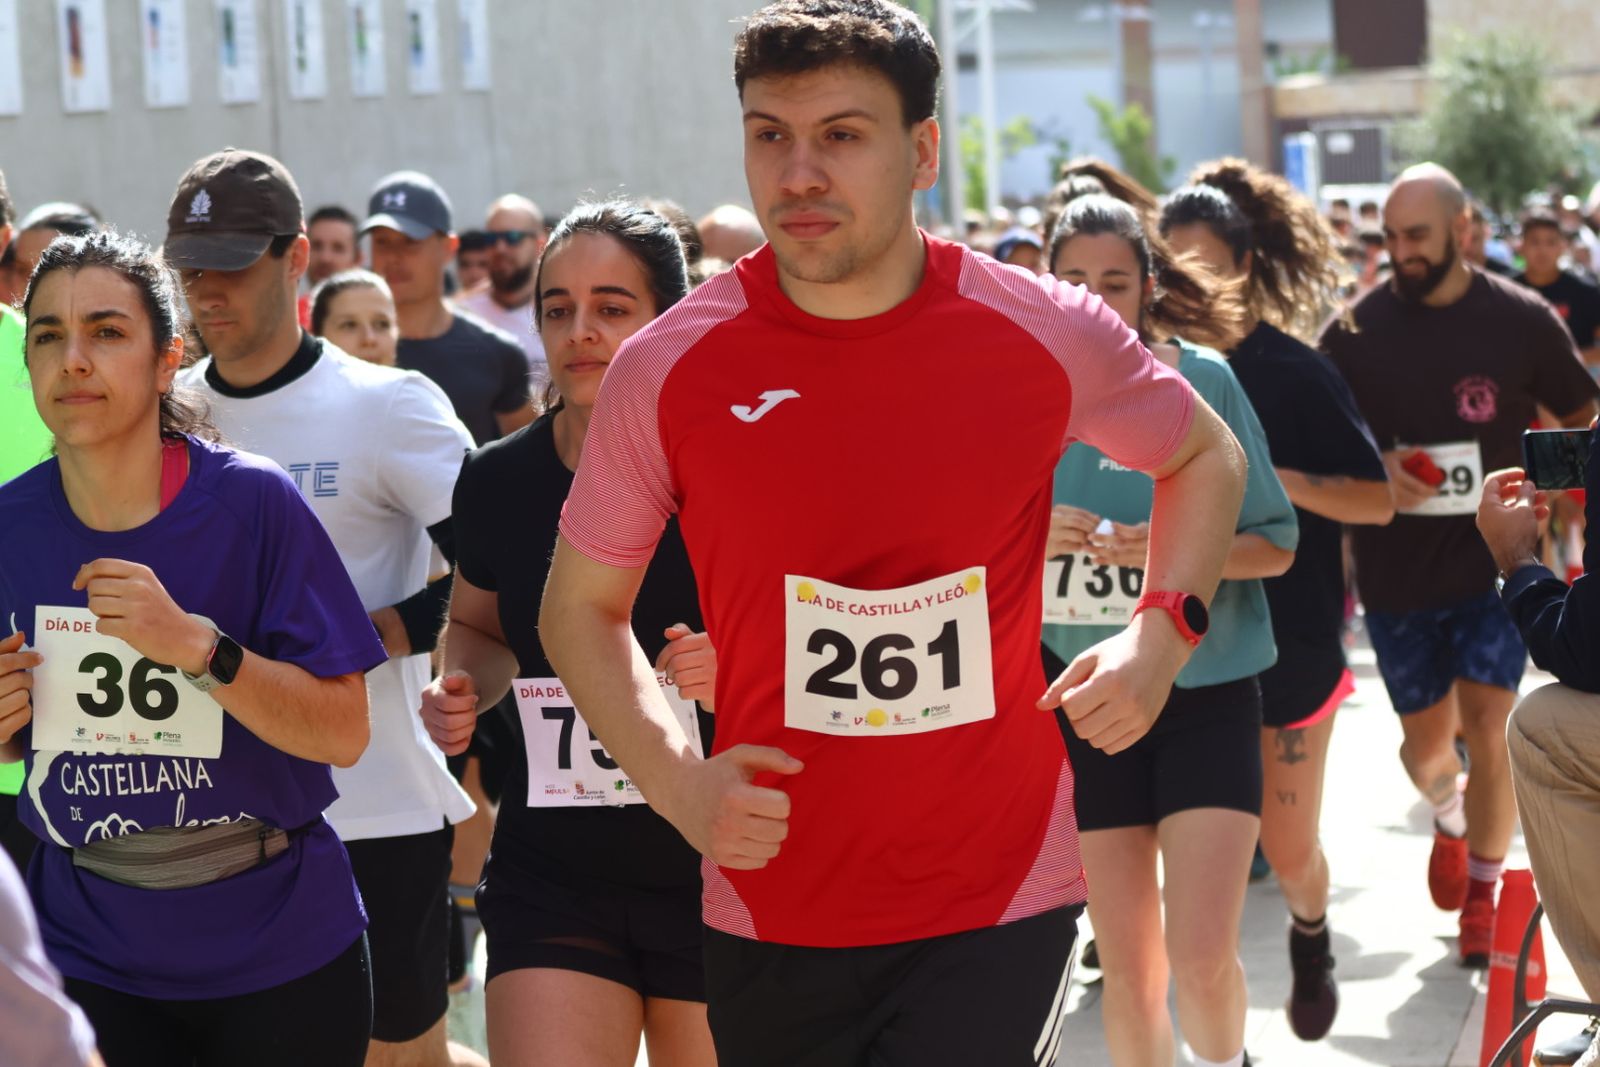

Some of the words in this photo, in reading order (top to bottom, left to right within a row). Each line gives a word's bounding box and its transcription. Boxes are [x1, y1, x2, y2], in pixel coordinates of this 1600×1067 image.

[1046, 553, 1144, 599] 736
[826, 598, 844, 612] DE
[848, 599, 922, 616] CASTILLA
[924, 595, 934, 607] Y
[937, 583, 968, 604] LEÓ
[46, 616, 70, 632] DÍA
[73, 621, 92, 633] DE
[805, 619, 960, 701] 261
[76, 652, 179, 721] 36
[520, 685, 544, 698] DÍA
[547, 687, 564, 698] DE
[163, 731, 181, 739] Plena
[61, 759, 213, 796] CASTELLANA
[70, 806, 83, 821] DE
